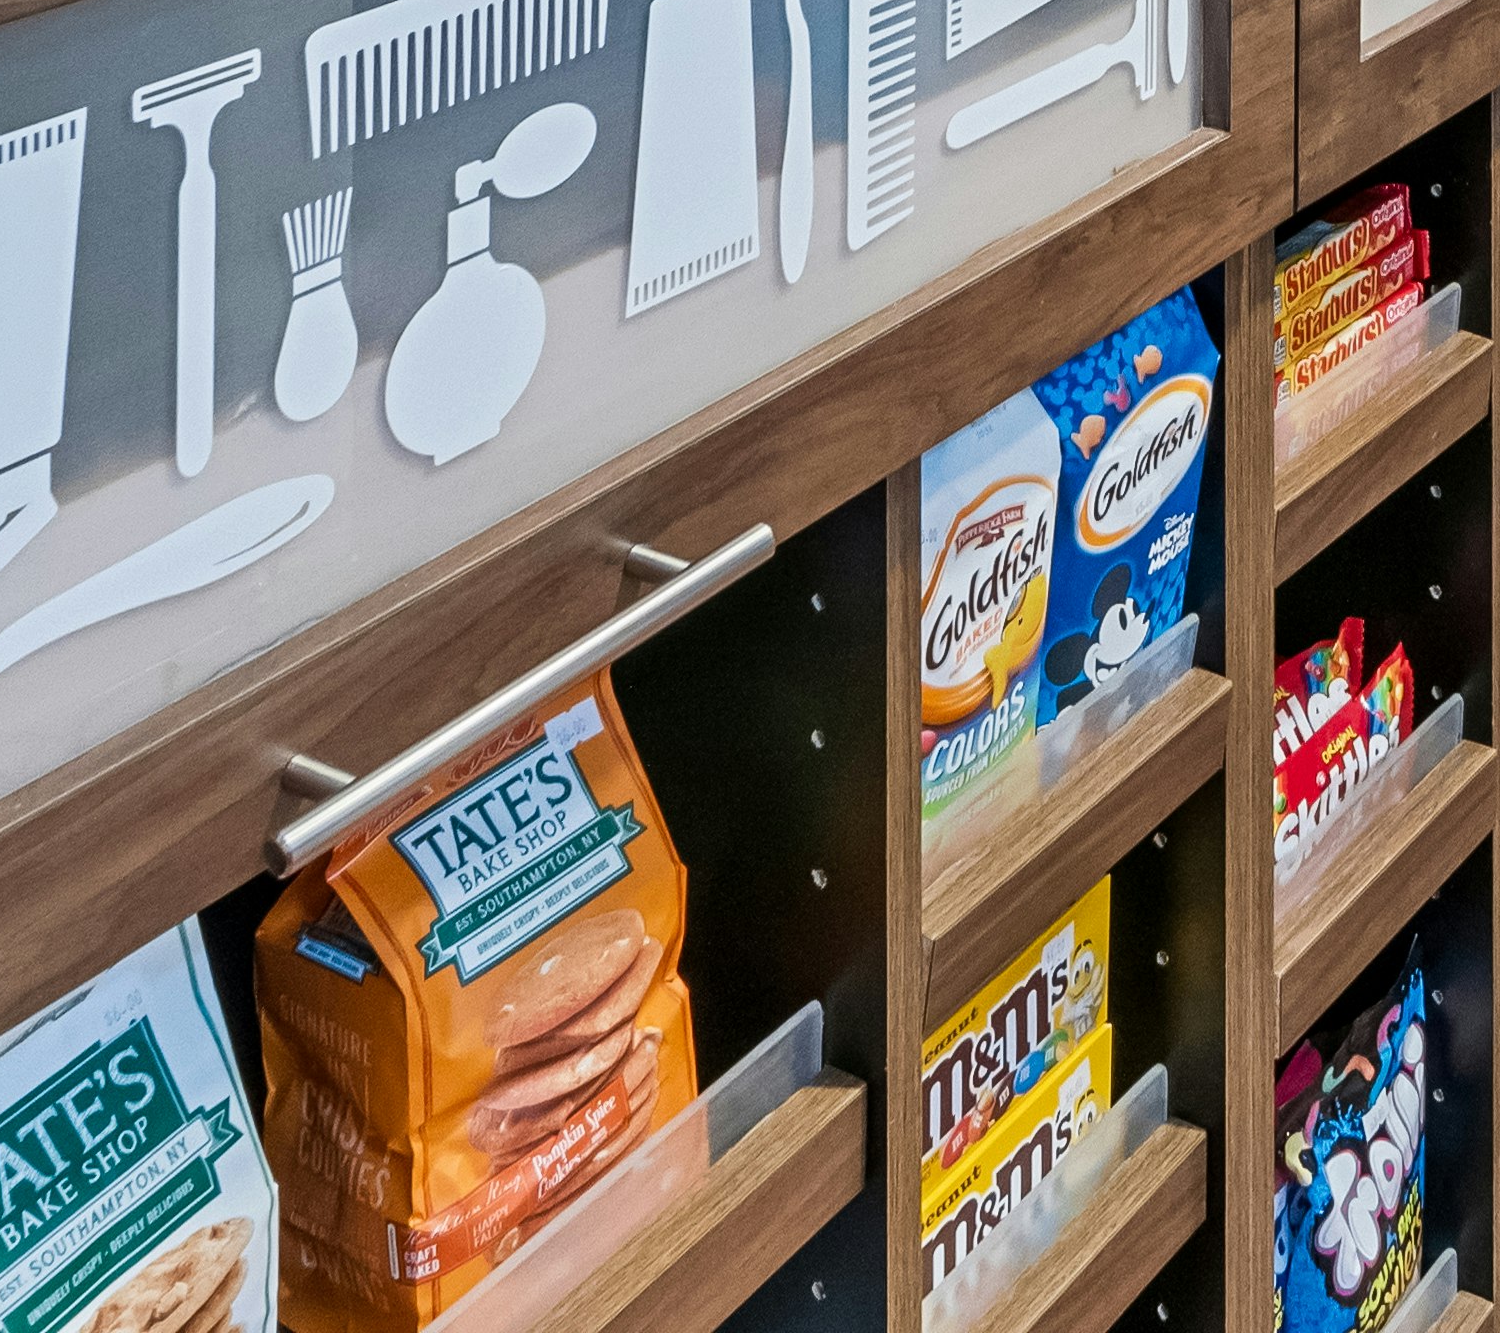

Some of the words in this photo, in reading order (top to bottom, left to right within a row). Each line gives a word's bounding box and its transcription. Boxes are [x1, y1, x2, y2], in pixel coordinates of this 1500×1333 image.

[1092, 403, 1198, 522] Goldfish
[1147, 512, 1195, 561] MICKEY
[1147, 534, 1191, 576] MOUSE
[926, 509, 1049, 671] Goldfish
[925, 680, 1027, 784] COLORS
[412, 754, 573, 880] TATE'S
[457, 852, 514, 896] BAKE
[518, 809, 567, 859] SHOP
[454, 909, 476, 934] EST.
[477, 844, 581, 917] SOUTHAMPTON,
[584, 826, 603, 848] NY
[81, 1115, 150, 1185] SHOP
[530, 1125, 587, 1177] Pumpkin
[583, 1094, 618, 1130] Spice
[27, 1164, 163, 1279] SOUTHAMPTON,
[161, 1136, 191, 1171] NY
[471, 1205, 510, 1238] HAPPY
[404, 1243, 439, 1264] CRAFT
[405, 1259, 440, 1280] BAKED
